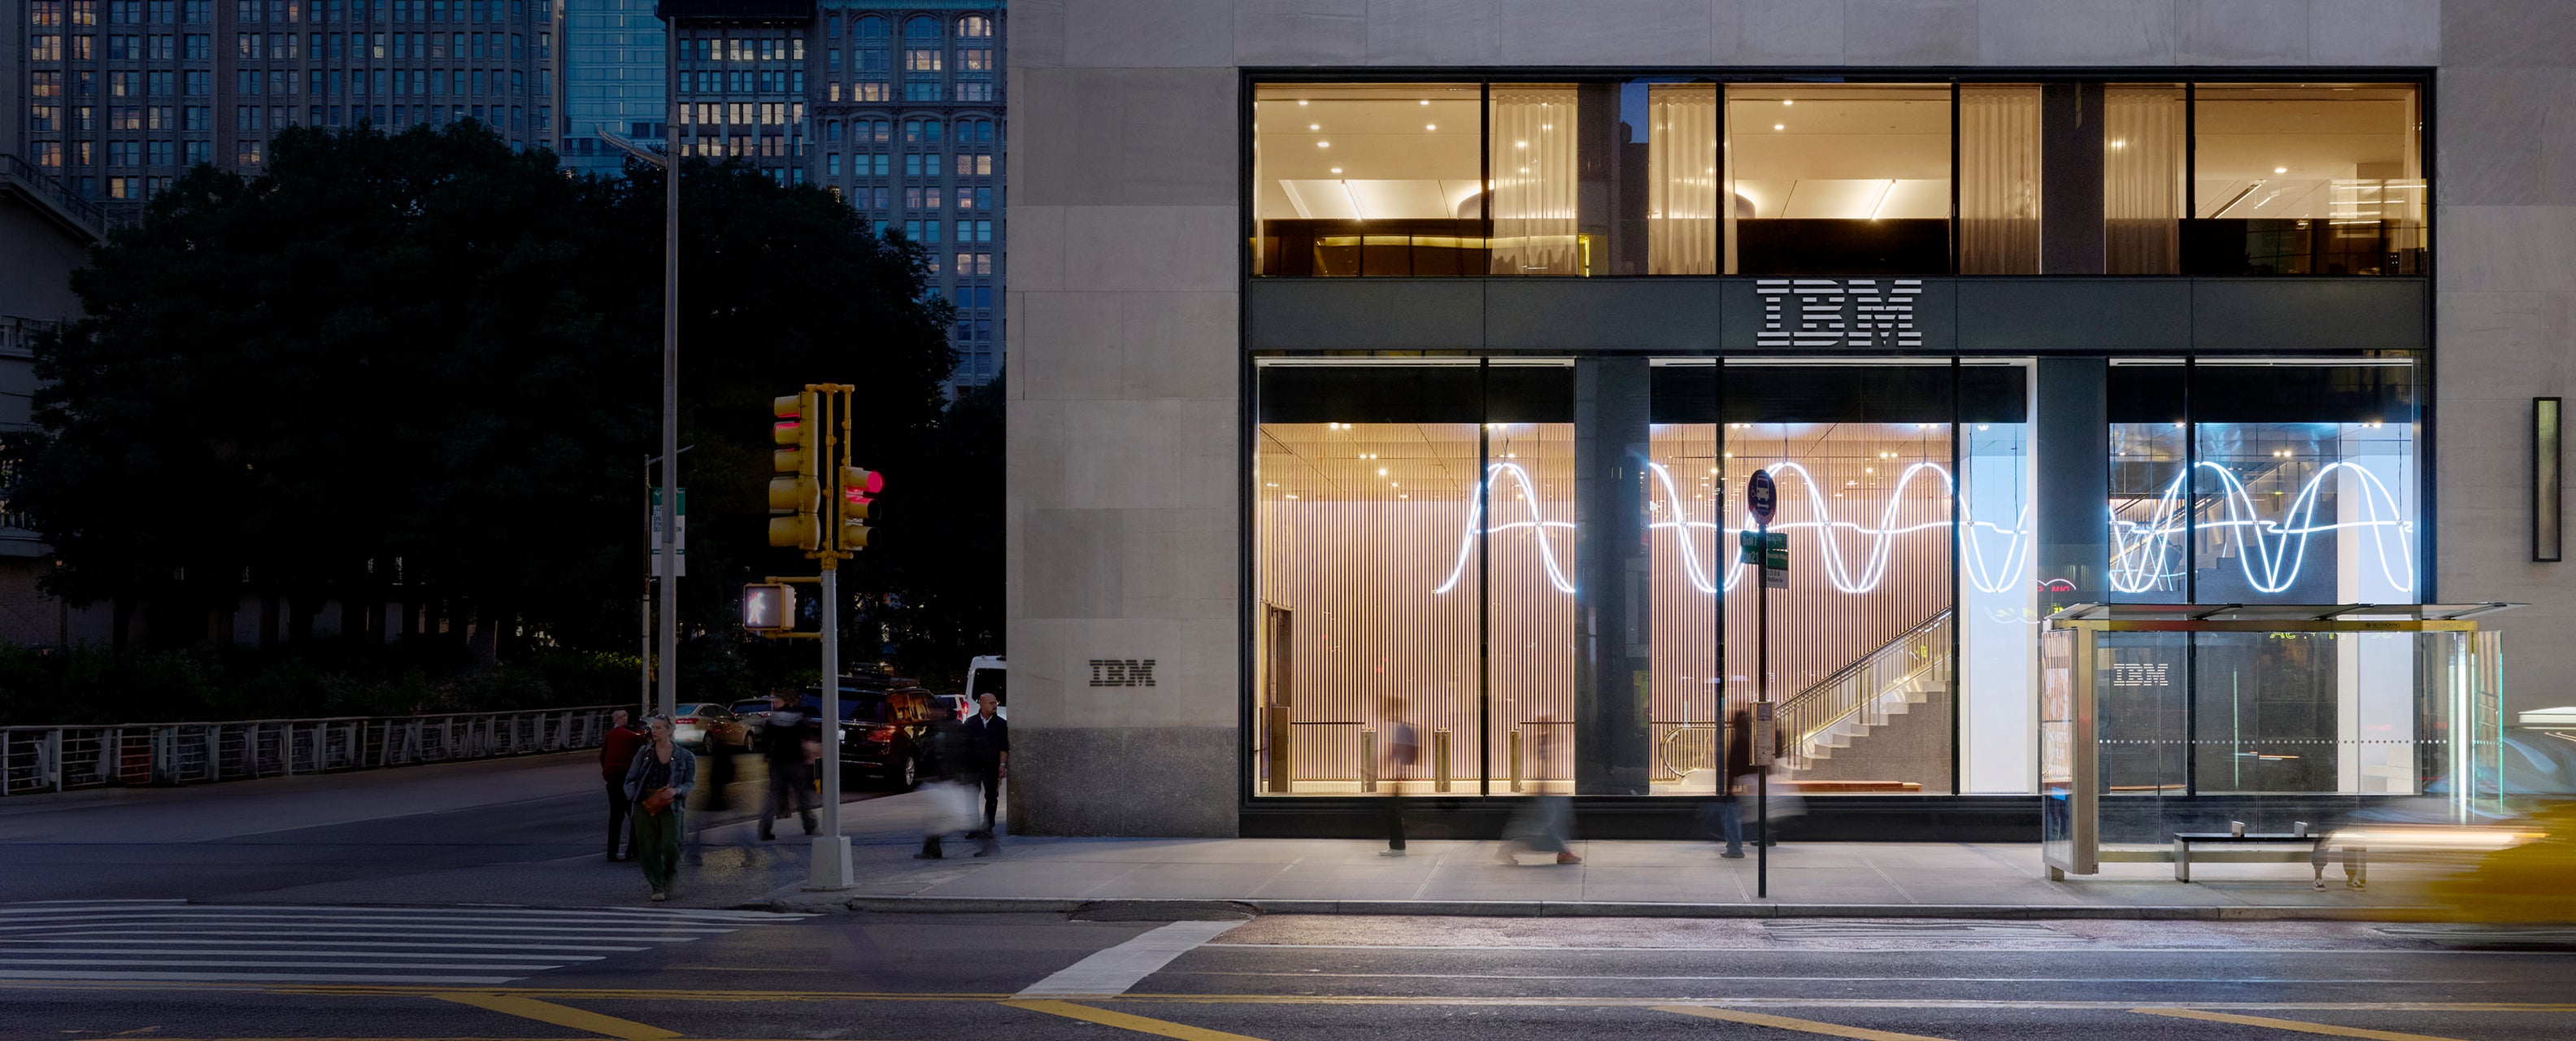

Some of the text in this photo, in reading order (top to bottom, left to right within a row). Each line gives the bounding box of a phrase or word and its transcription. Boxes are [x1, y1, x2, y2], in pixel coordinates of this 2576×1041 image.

[1756, 279, 1921, 346] IBM
[1090, 660, 1155, 686] IBM
[2114, 664, 2168, 686] IBM
